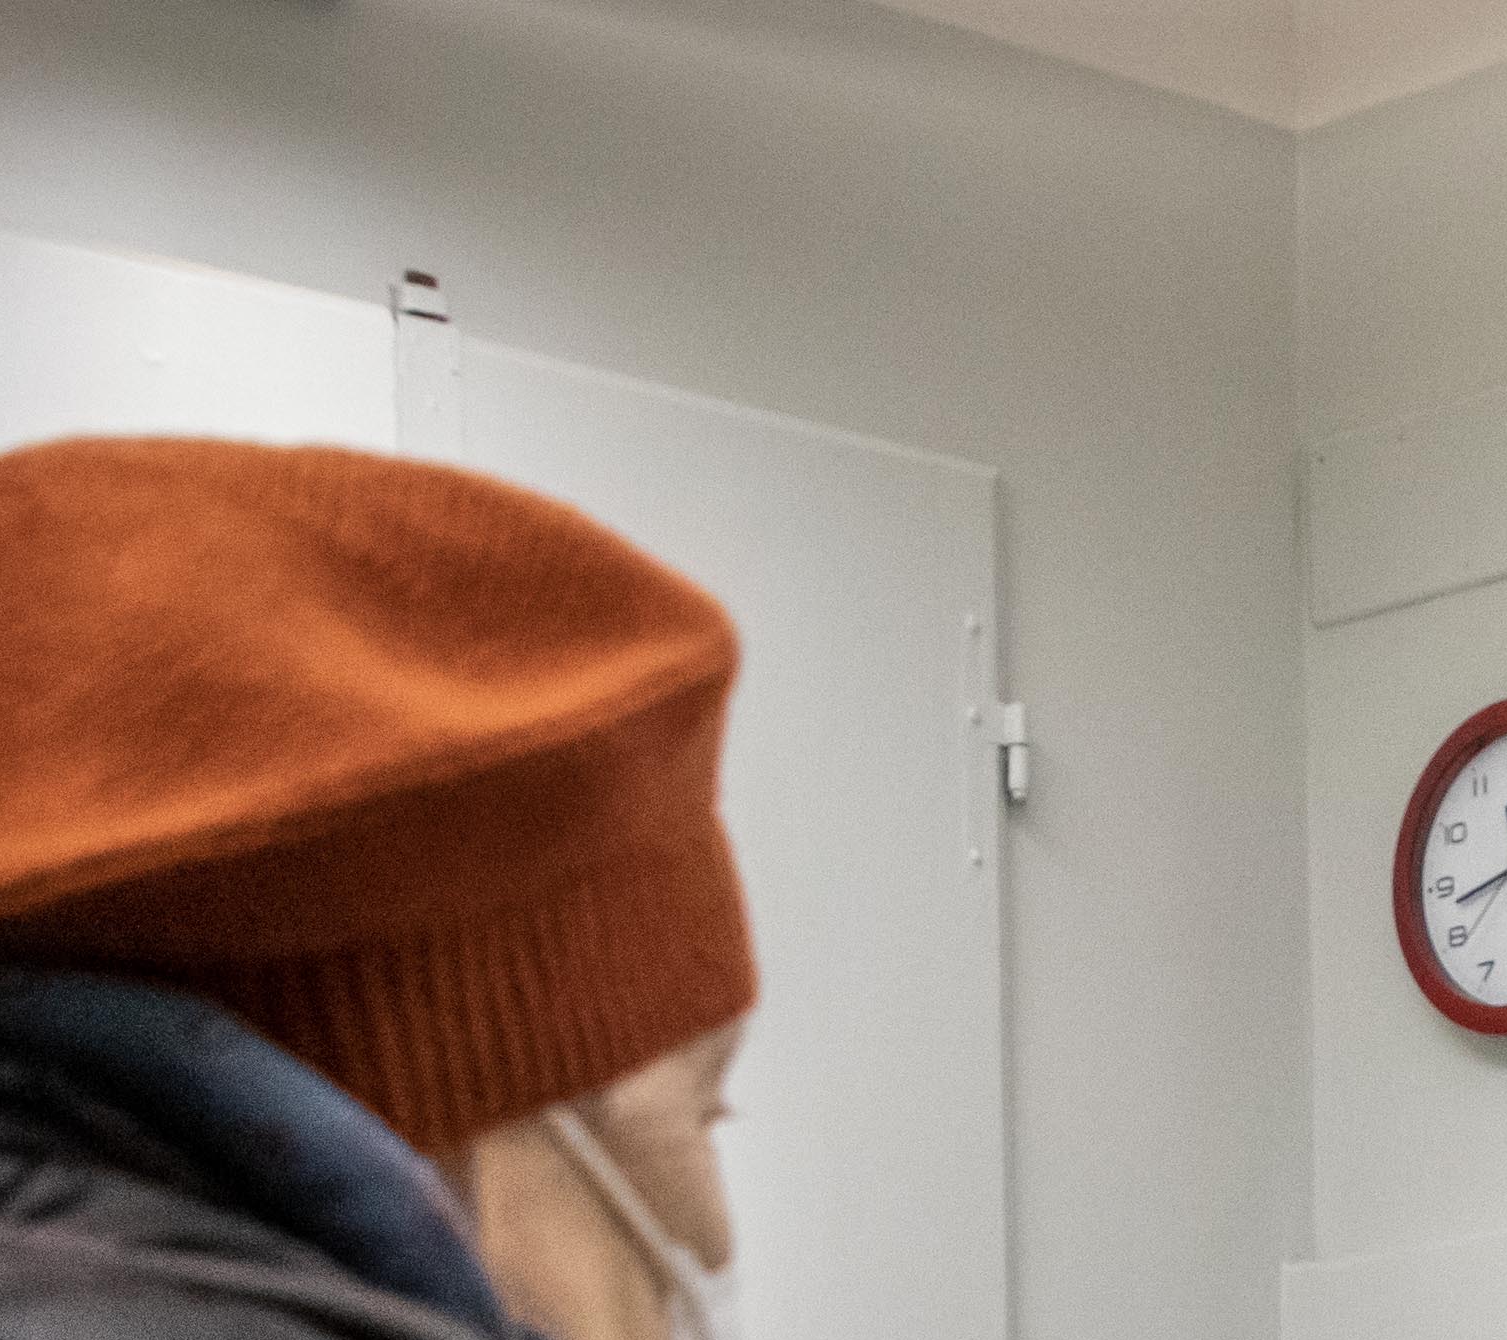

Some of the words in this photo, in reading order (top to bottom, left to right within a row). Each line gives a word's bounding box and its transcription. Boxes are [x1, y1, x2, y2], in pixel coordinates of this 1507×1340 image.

[1472, 773, 1489, 797] 11
[1444, 822, 1468, 845] 10
[1435, 876, 1455, 898] 9
[1448, 925, 1468, 947] 8
[1478, 960, 1495, 982] 7
